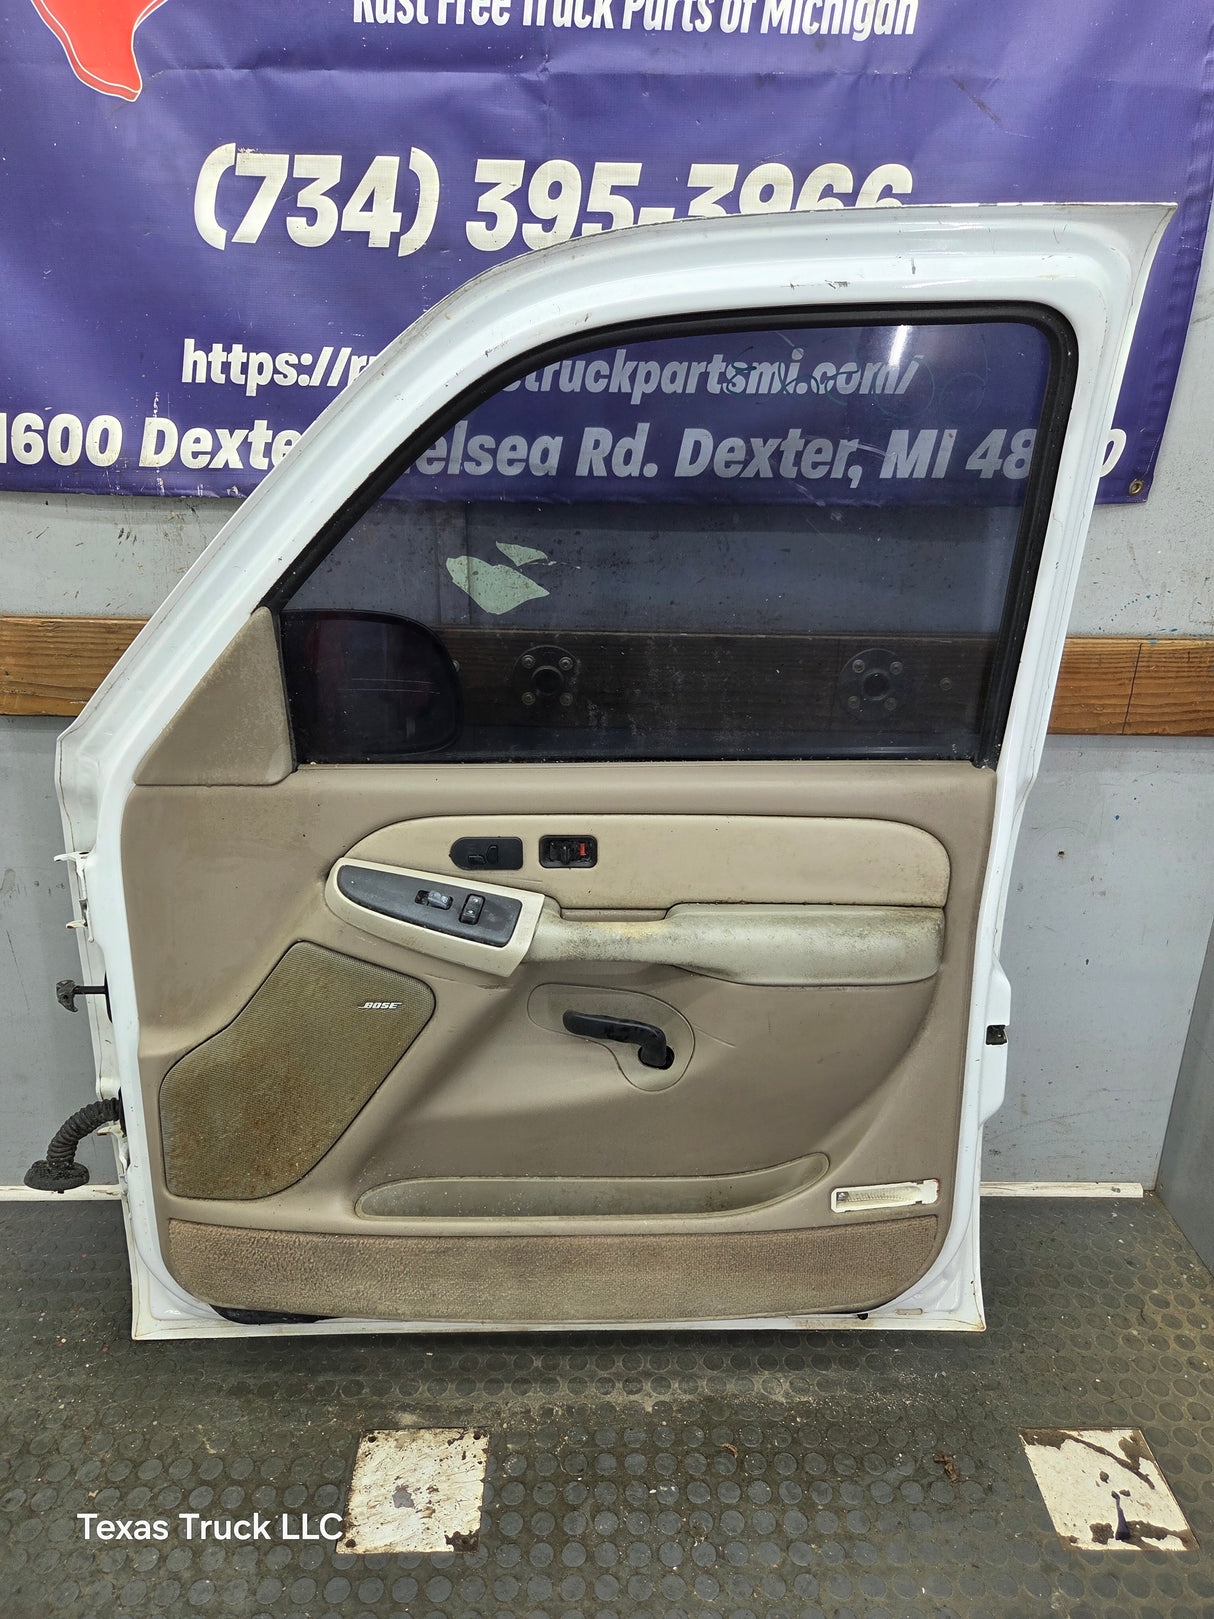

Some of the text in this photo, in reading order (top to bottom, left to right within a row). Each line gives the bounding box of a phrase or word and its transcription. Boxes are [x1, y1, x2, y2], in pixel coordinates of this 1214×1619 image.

[621, 0, 714, 32] Parts
[720, 0, 755, 33] of
[760, 0, 919, 41] Michigan
[194, 142, 440, 257] (734)
[139, 417, 303, 470] Dexte
[404, 420, 564, 476] elsea
[575, 422, 658, 478] Rd.
[674, 428, 860, 489] Dexter,
[879, 428, 958, 479] MI
[358, 1001, 402, 1009] BOSE
